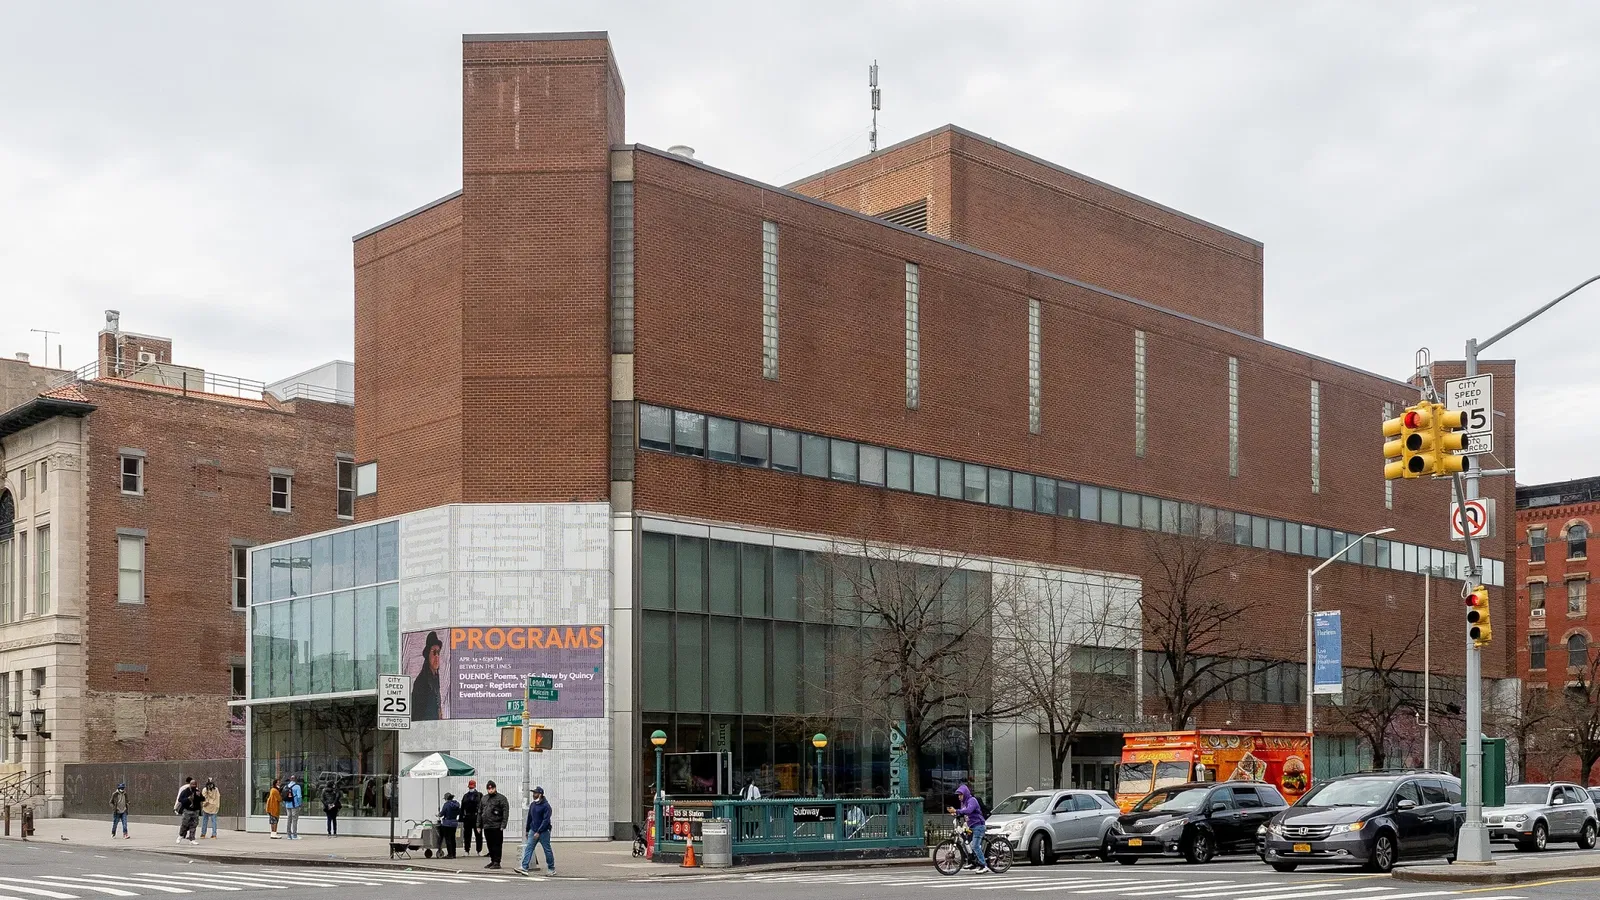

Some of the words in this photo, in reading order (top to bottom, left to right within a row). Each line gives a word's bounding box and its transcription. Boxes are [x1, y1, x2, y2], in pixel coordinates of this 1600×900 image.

[1459, 381, 1477, 389] CITY
[1455, 389, 1481, 399] SPEED
[1457, 398, 1479, 407] LIMIT
[450, 626, 604, 650] PROGRAMS
[494, 673, 519, 681] Poems,
[559, 672, 568, 680] by
[569, 672, 594, 680] Quincy
[459, 682, 484, 690] Troupe
[489, 682, 519, 690] Register
[530, 677, 546, 687] Lenox
[383, 697, 407, 712] 25
[688, 809, 704, 817] Station
[793, 806, 820, 817] Subway
